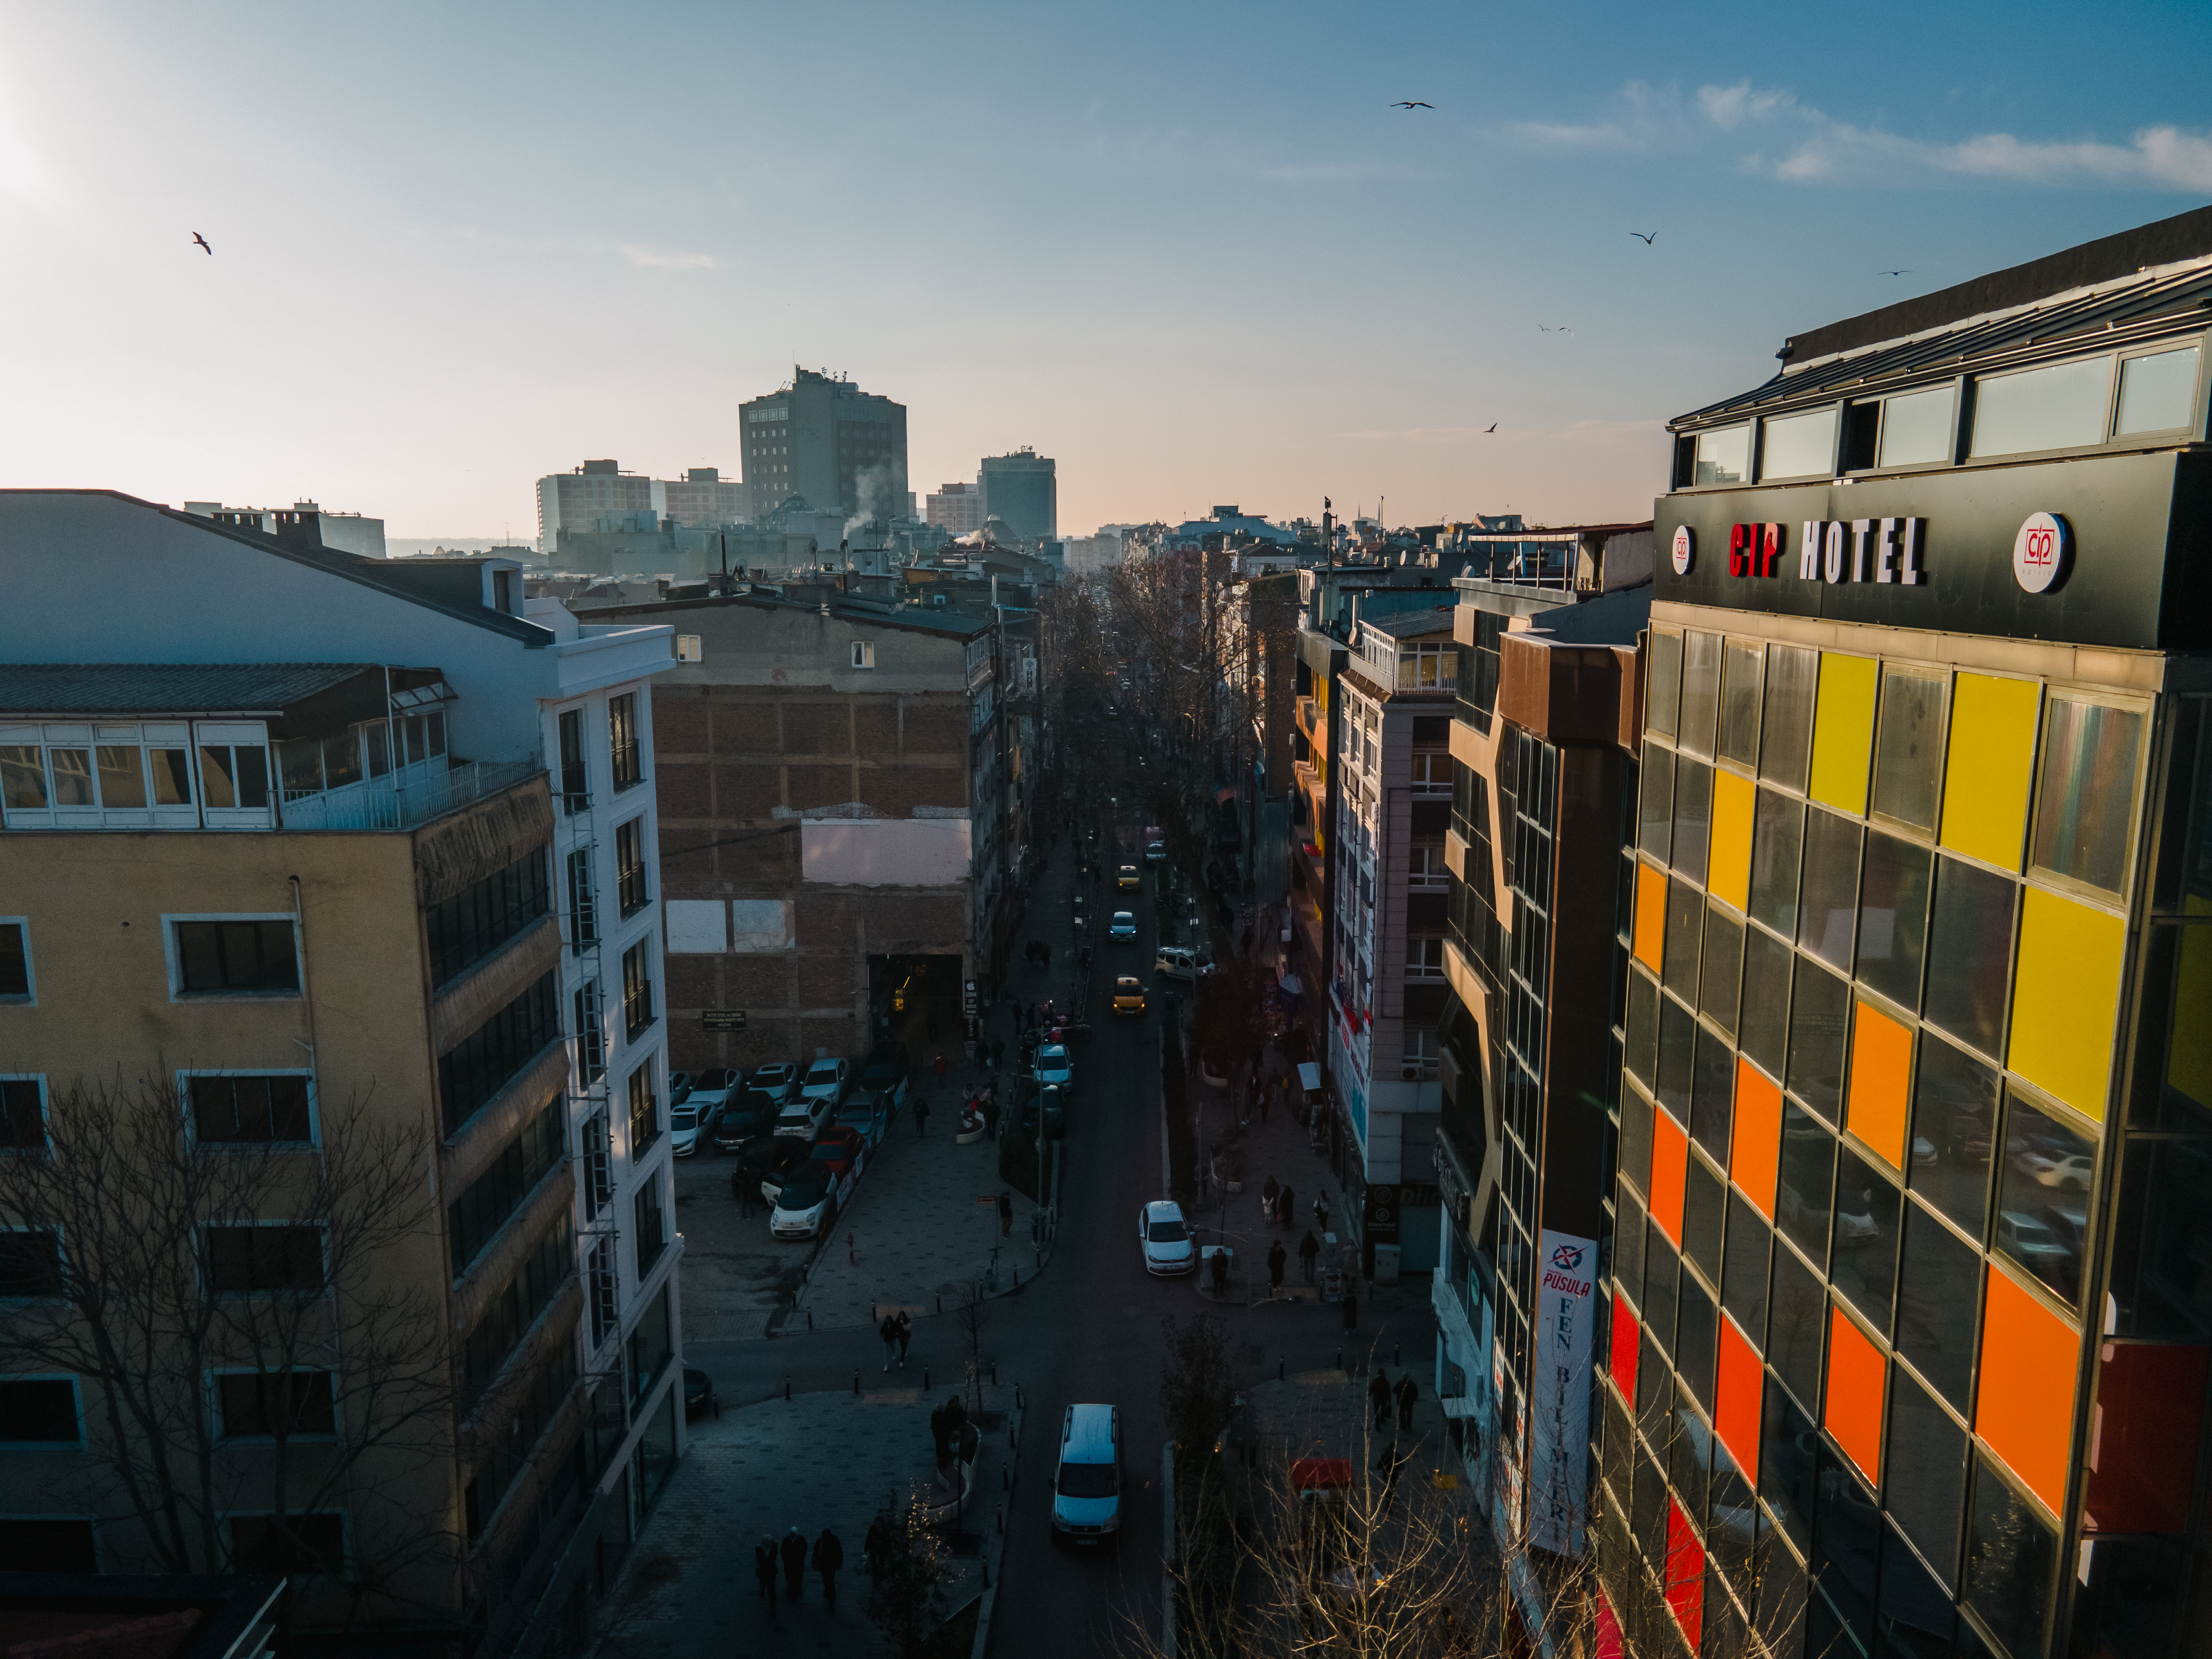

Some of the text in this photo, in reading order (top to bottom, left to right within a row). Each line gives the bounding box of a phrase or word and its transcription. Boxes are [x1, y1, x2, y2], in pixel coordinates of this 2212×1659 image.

[1729, 517, 1917, 585] CIP HOTEL
[1543, 1272, 1591, 1297] PUSULA
[1556, 1297, 1573, 1352] FEN
